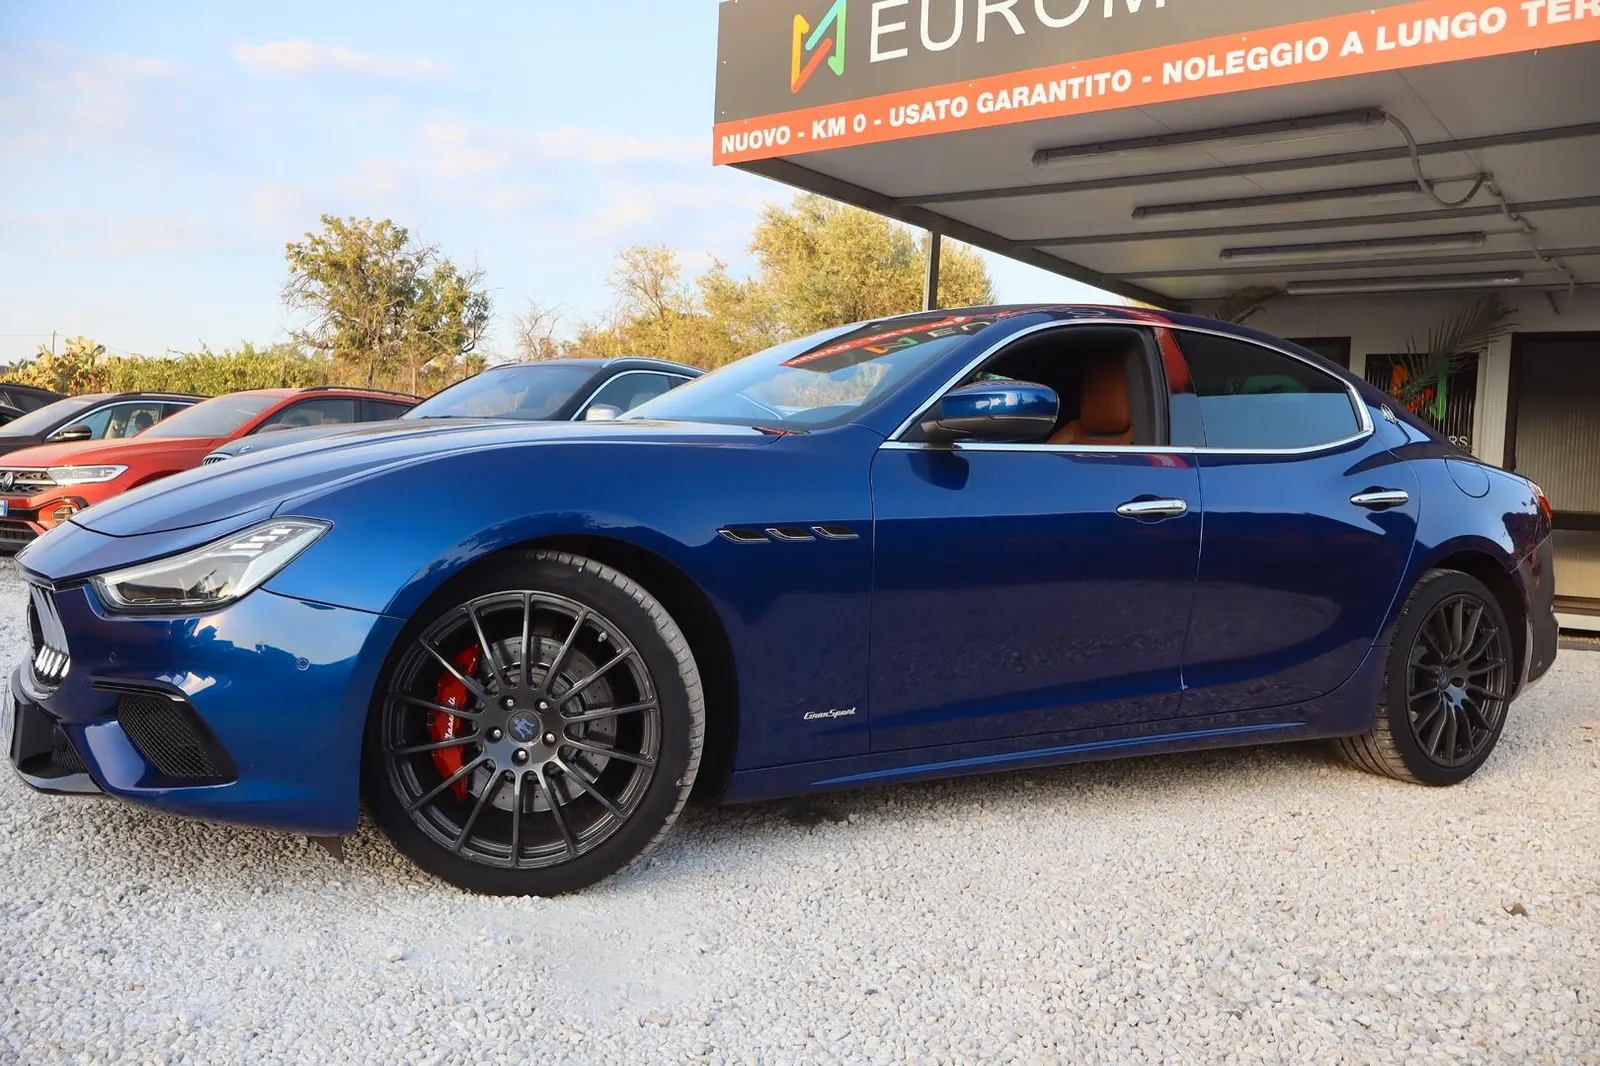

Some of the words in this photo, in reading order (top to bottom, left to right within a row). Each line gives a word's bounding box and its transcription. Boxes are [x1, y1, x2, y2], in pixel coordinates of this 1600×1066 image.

[721, 126, 790, 154] NUOVO
[811, 116, 846, 140] KM
[853, 113, 866, 133] 0
[889, 99, 968, 128] USATO
[976, 69, 1132, 112] GARANTITO
[1163, 36, 1329, 85] NOLEGGIO
[1340, 31, 1364, 56] A
[1376, 6, 1507, 50] LUNGO
